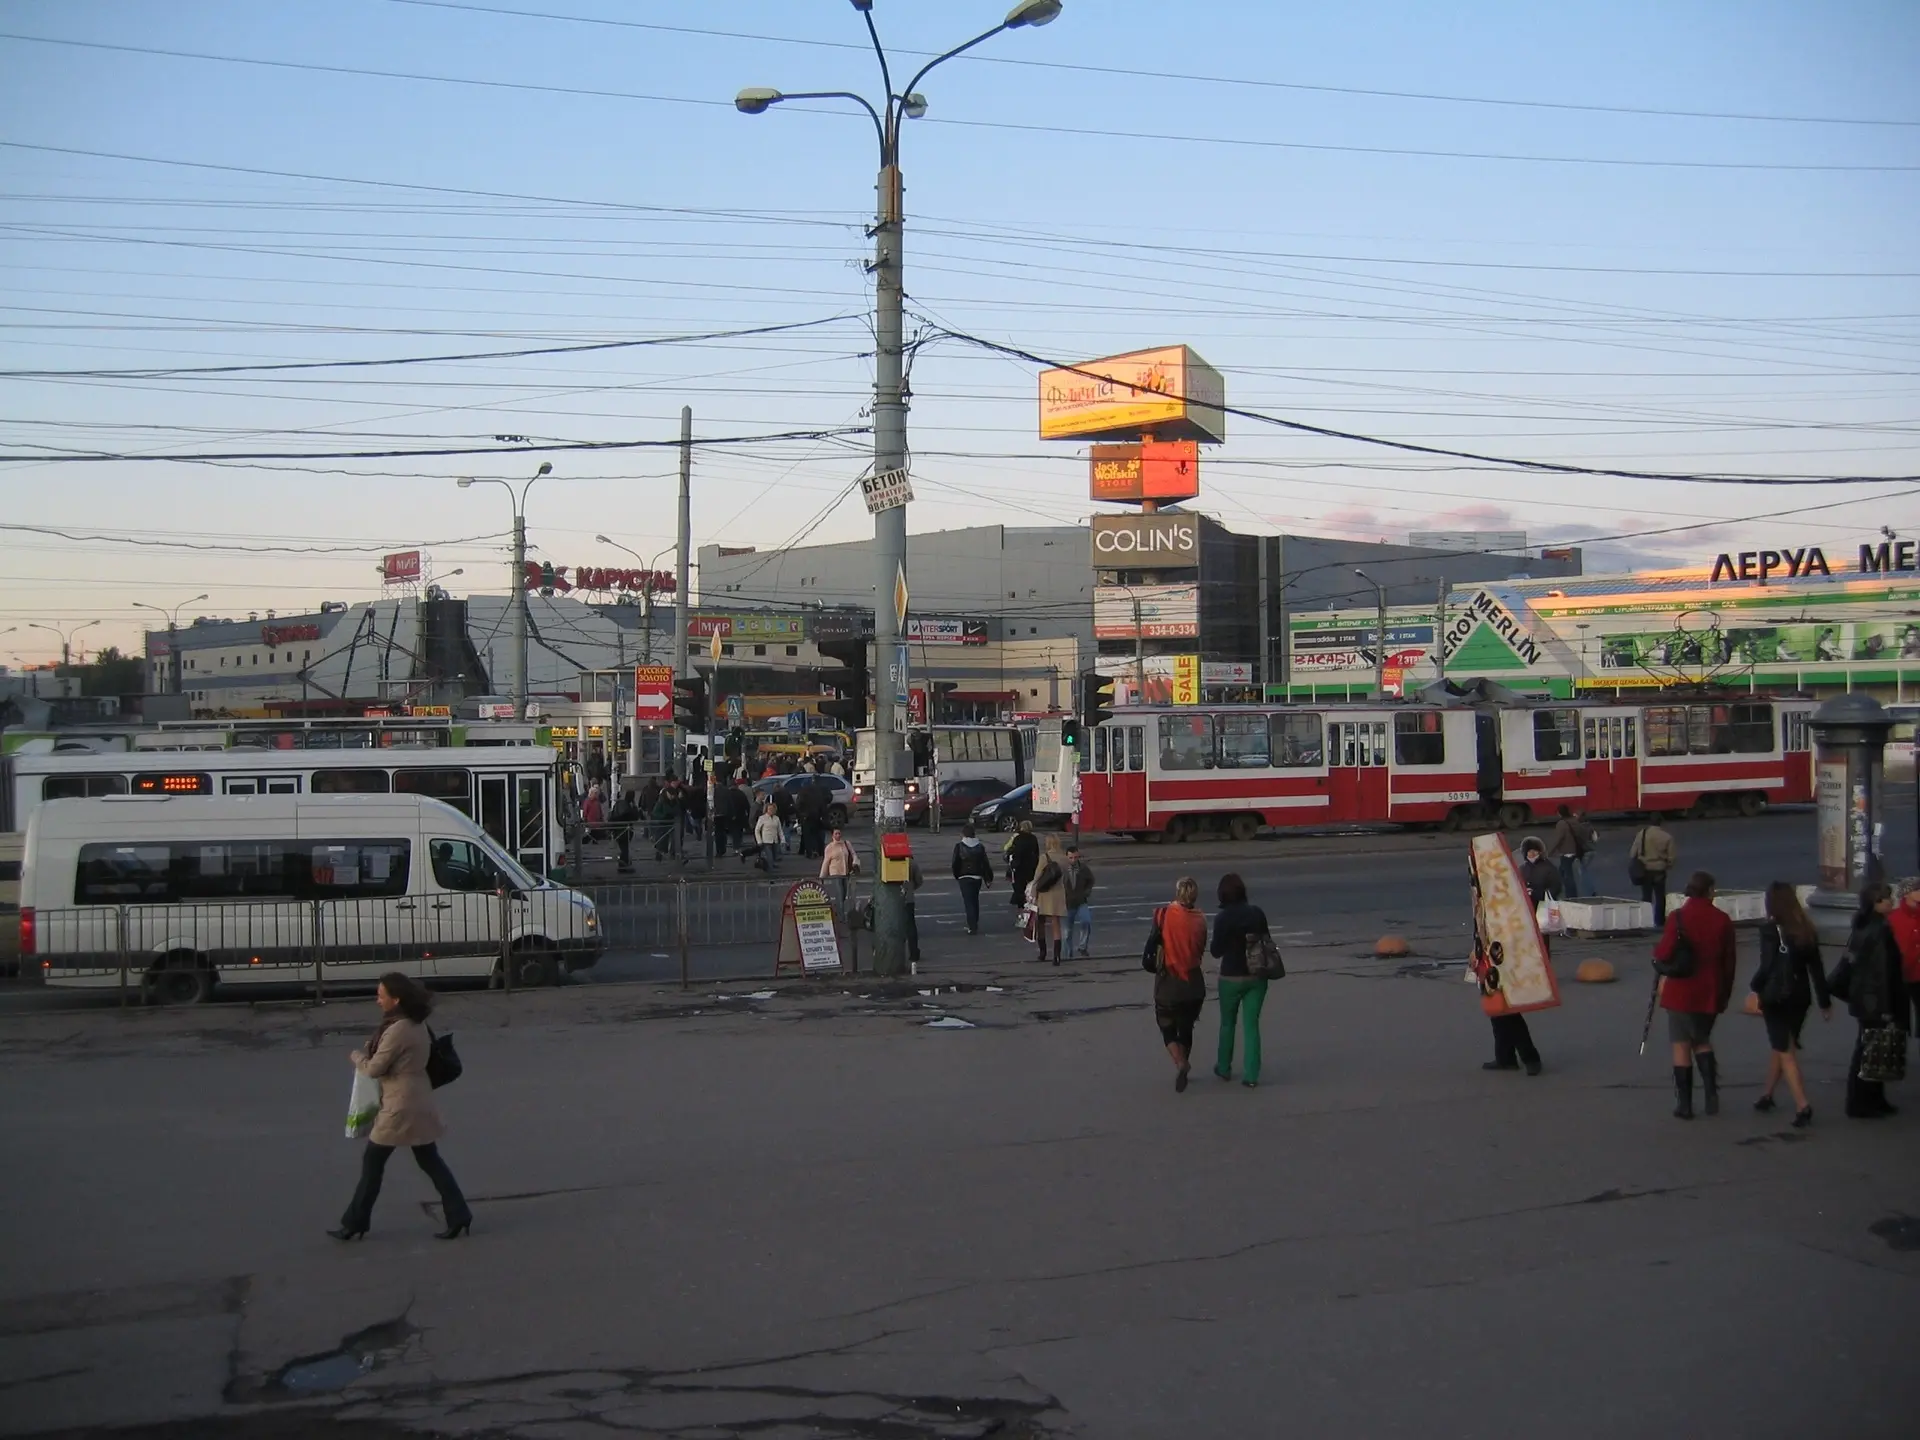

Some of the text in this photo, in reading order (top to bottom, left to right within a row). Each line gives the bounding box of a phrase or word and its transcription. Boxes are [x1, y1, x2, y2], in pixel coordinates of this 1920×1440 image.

[1094, 461, 1119, 471] Jack
[1095, 469, 1138, 480] Wolfskin
[862, 469, 907, 494] БЕТОН
[1099, 479, 1133, 488] STORE
[869, 485, 908, 503] АРМАТУРА
[1095, 523, 1194, 552] COLIN'S
[396, 557, 418, 571] МИР
[1710, 547, 1831, 582] ЛЕРУА
[1552, 609, 1568, 617] ДОМ
[701, 622, 730, 632] МИР
[1149, 624, 1196, 636] 334-0-334
[1429, 591, 1542, 666] LEROY MERLIN
[1368, 633, 1395, 641] Reok
[1294, 653, 1357, 665] ВАСАБИ
[1397, 654, 1403, 665] 2
[638, 674, 670, 682] ЗОЛОТО
[1179, 657, 1192, 703] SALE
[1448, 792, 1470, 801] 5099
